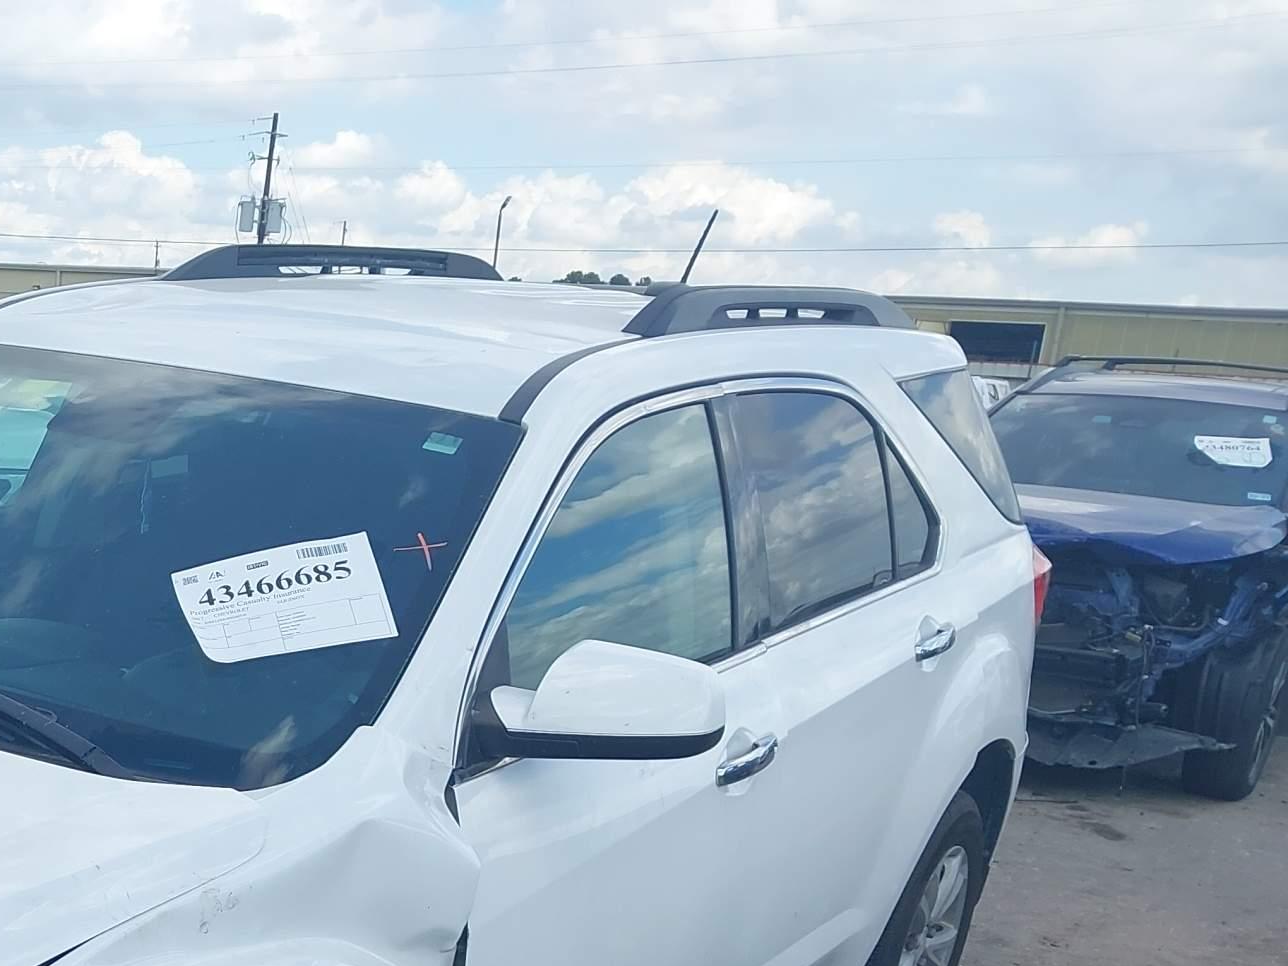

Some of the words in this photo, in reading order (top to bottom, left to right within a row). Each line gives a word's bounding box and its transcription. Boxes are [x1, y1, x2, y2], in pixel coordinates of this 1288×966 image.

[190, 604, 235, 616] Progressive
[237, 595, 271, 607] Casualty
[273, 587, 311, 600] Insurance
[198, 560, 352, 606] 43466685
